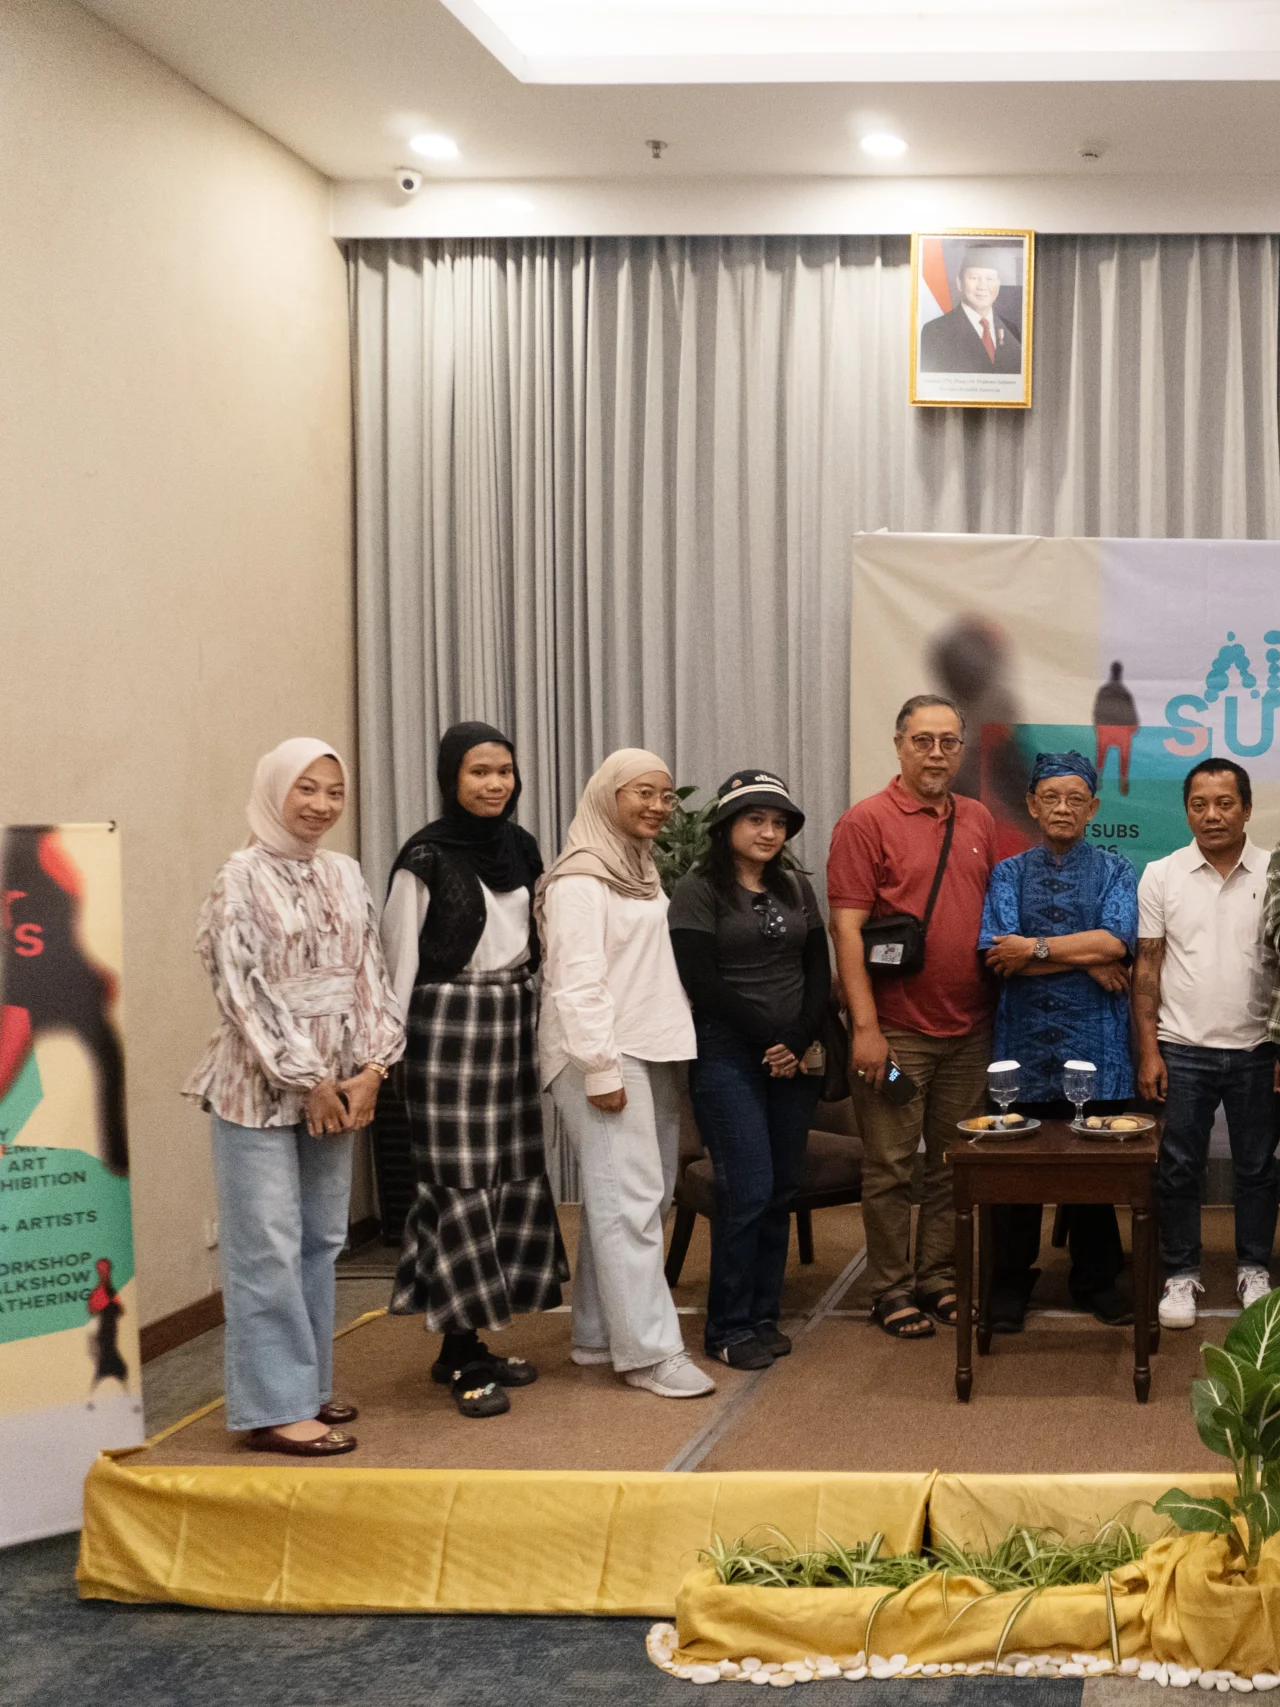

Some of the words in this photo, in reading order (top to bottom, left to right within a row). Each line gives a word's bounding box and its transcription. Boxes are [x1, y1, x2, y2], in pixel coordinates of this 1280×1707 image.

[1083, 824, 1140, 838] TSUBS
[8, 1157, 47, 1173] ART
[0, 1170, 88, 1193] HIBITION
[16, 1210, 98, 1233] ARTISTS
[0, 1252, 92, 1277] ORKSHOP
[0, 1270, 91, 1295] LKSHOW
[0, 1288, 93, 1314] THERING
